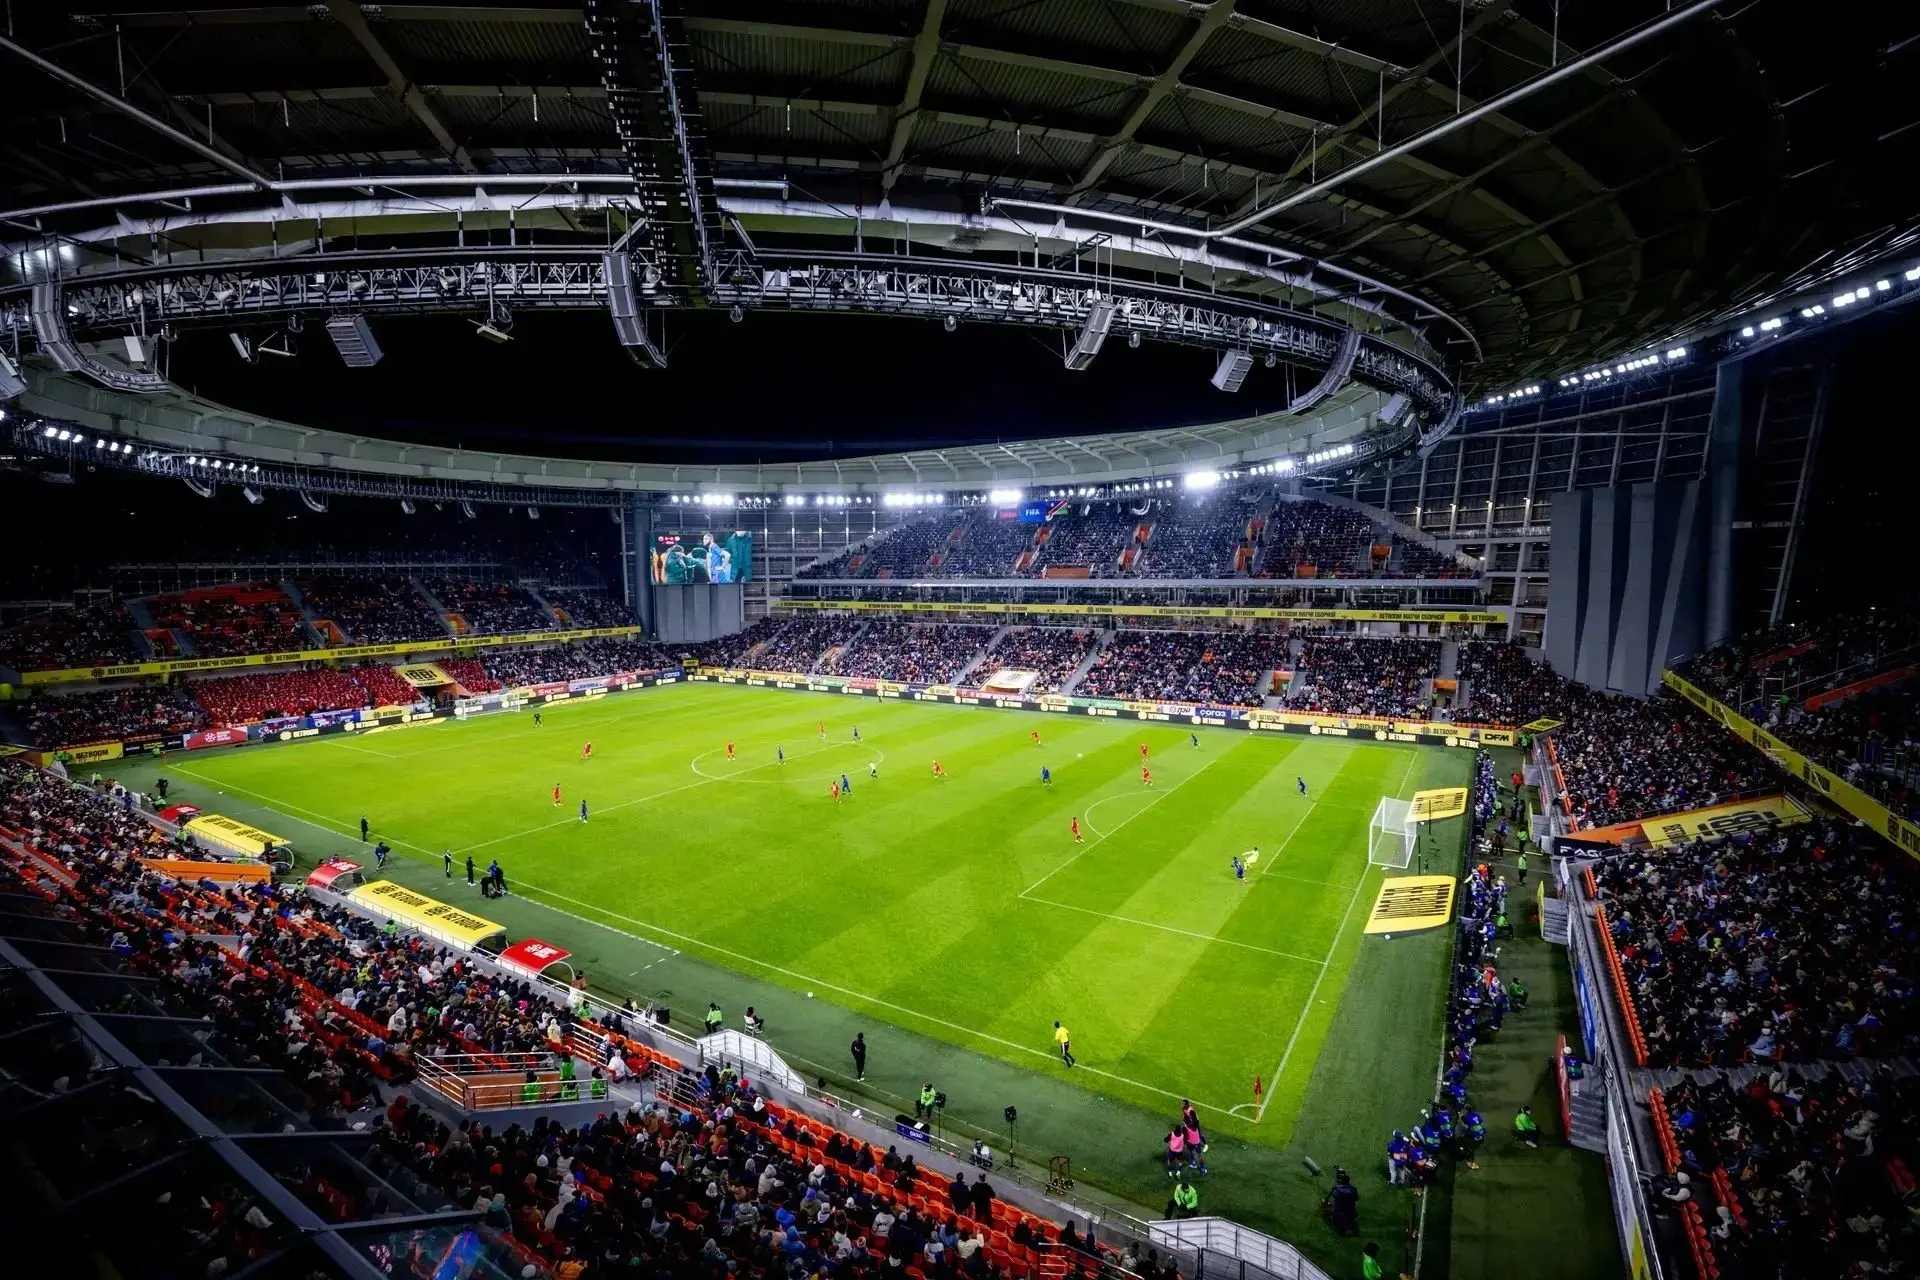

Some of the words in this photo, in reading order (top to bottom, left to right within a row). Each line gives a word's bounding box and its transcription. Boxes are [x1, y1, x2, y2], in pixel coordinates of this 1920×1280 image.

[1025, 508, 1040, 516] FIFA
[107, 666, 140, 675] BETBOOM
[1484, 733, 1510, 742] DFM
[75, 749, 109, 760] BETBOOM
[442, 910, 488, 931] BETBOOM
